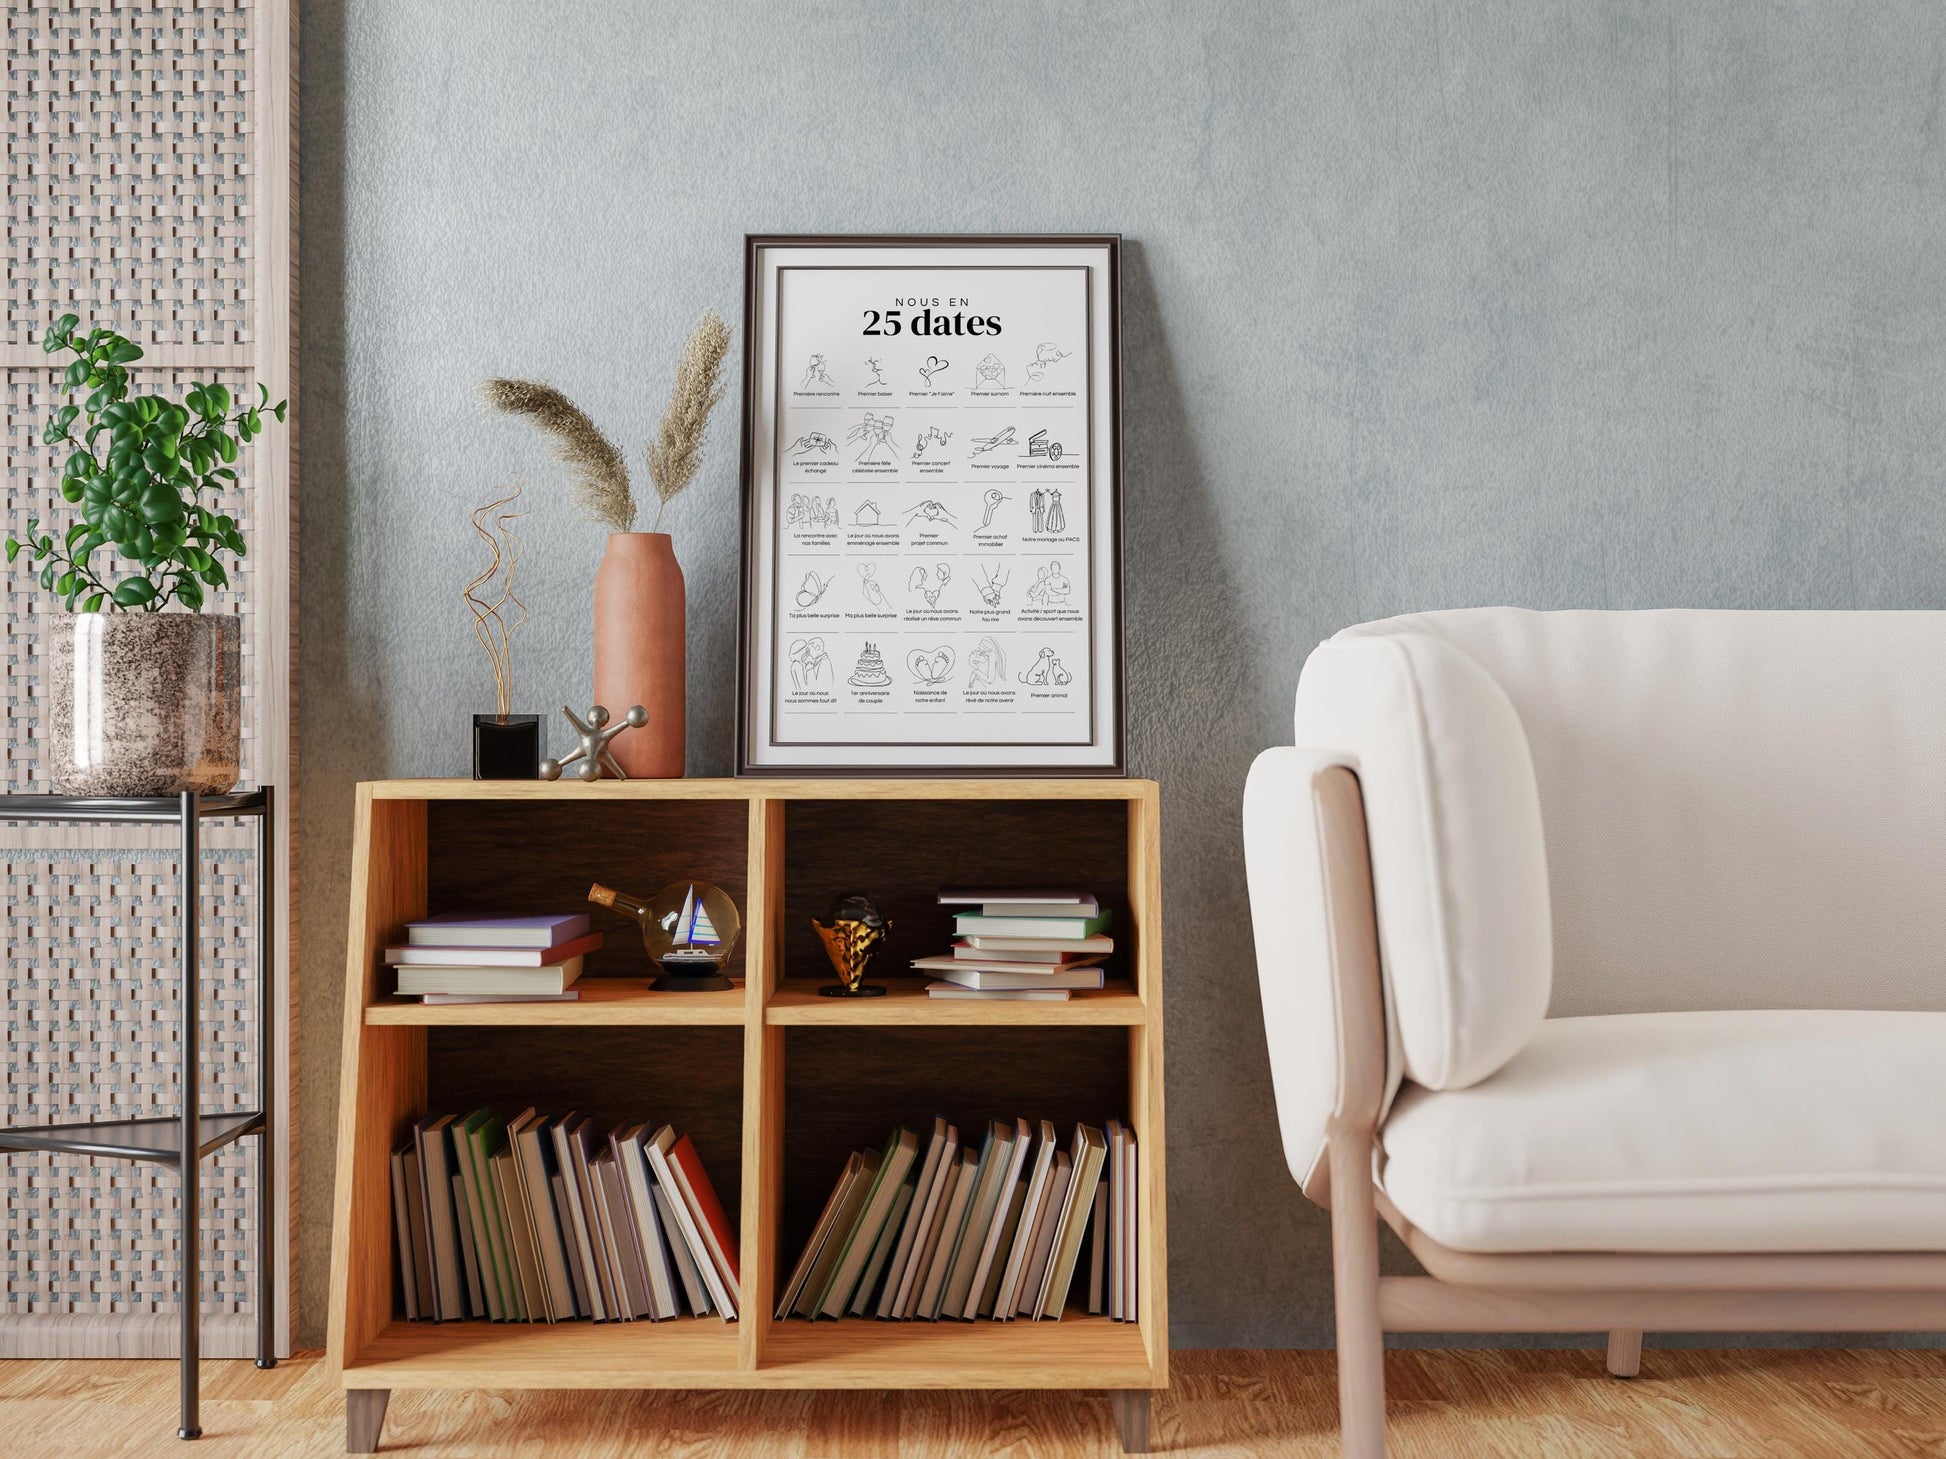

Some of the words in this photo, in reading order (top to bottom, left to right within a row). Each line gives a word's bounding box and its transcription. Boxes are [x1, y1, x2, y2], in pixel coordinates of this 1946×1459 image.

[895, 297, 940, 307] NOUS
[949, 297, 969, 307] EN
[862, 308, 902, 337] 25
[910, 308, 1002, 337] dates
